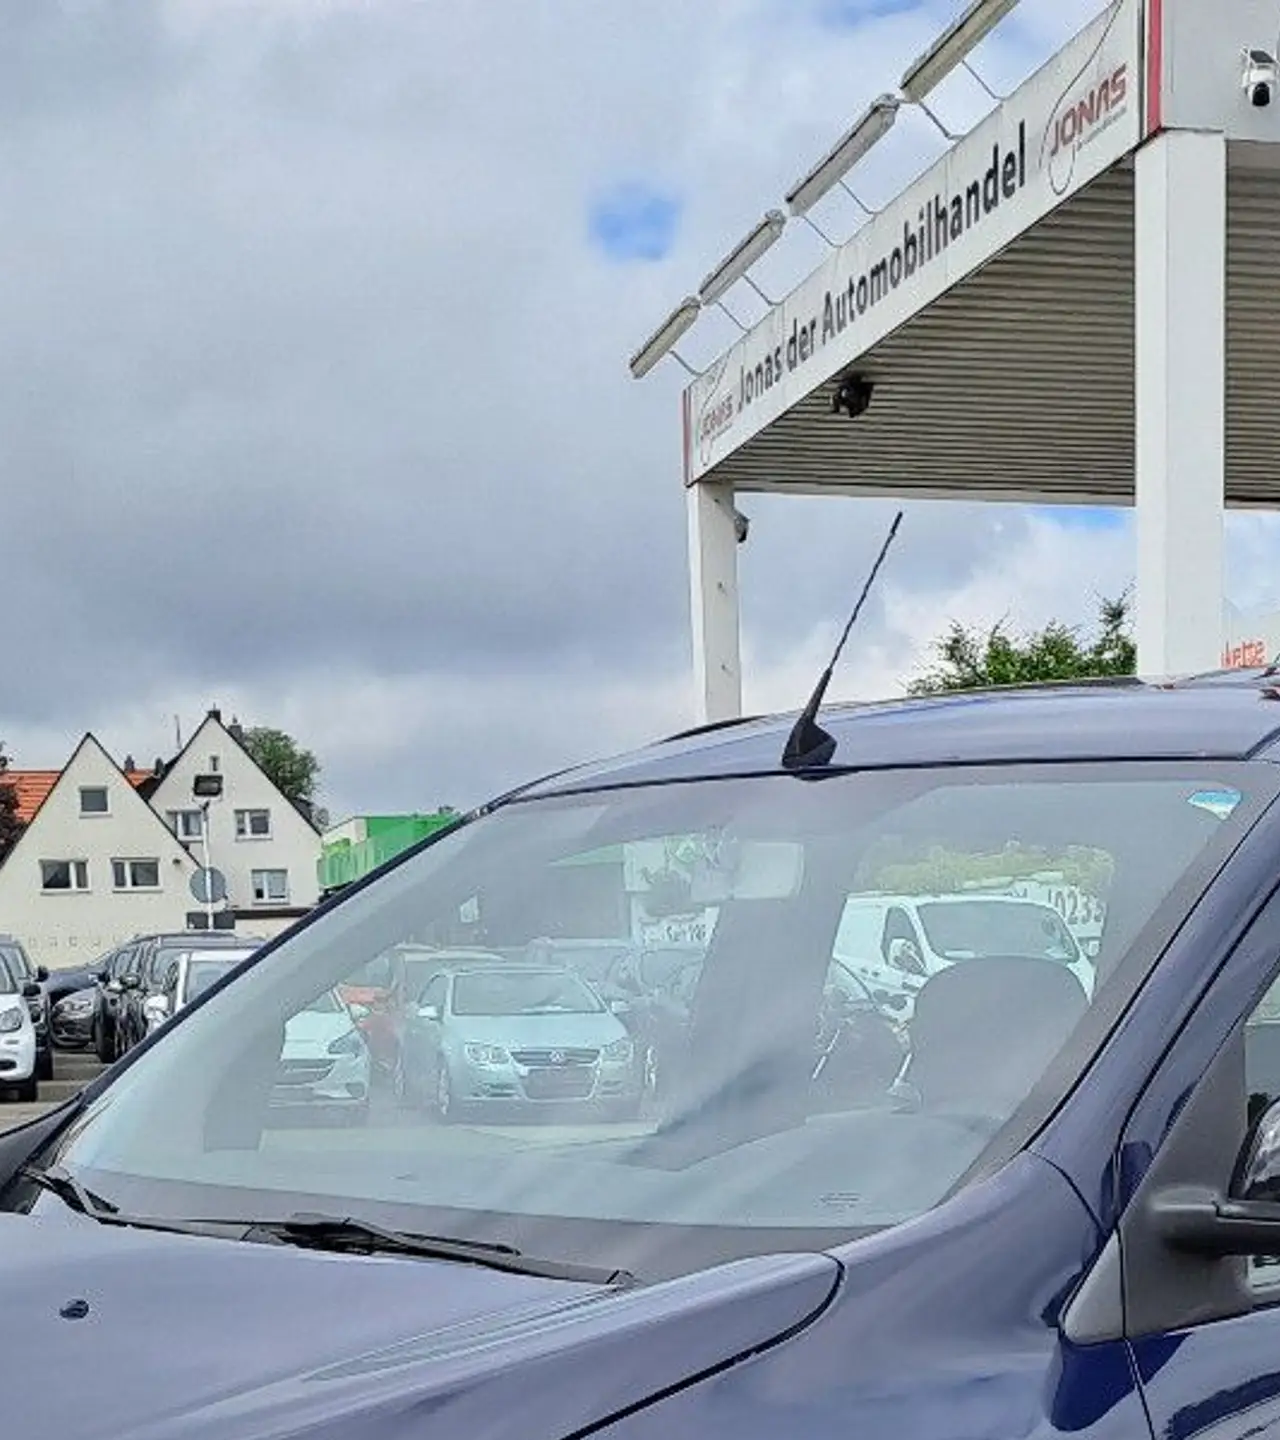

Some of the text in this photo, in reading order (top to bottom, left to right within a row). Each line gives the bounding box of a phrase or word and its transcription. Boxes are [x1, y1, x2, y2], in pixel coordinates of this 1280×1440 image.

[1051, 63, 1126, 156] JONAS
[738, 346, 782, 413] Jonas
[786, 317, 816, 372] der
[822, 120, 1025, 345] Automobilhandel
